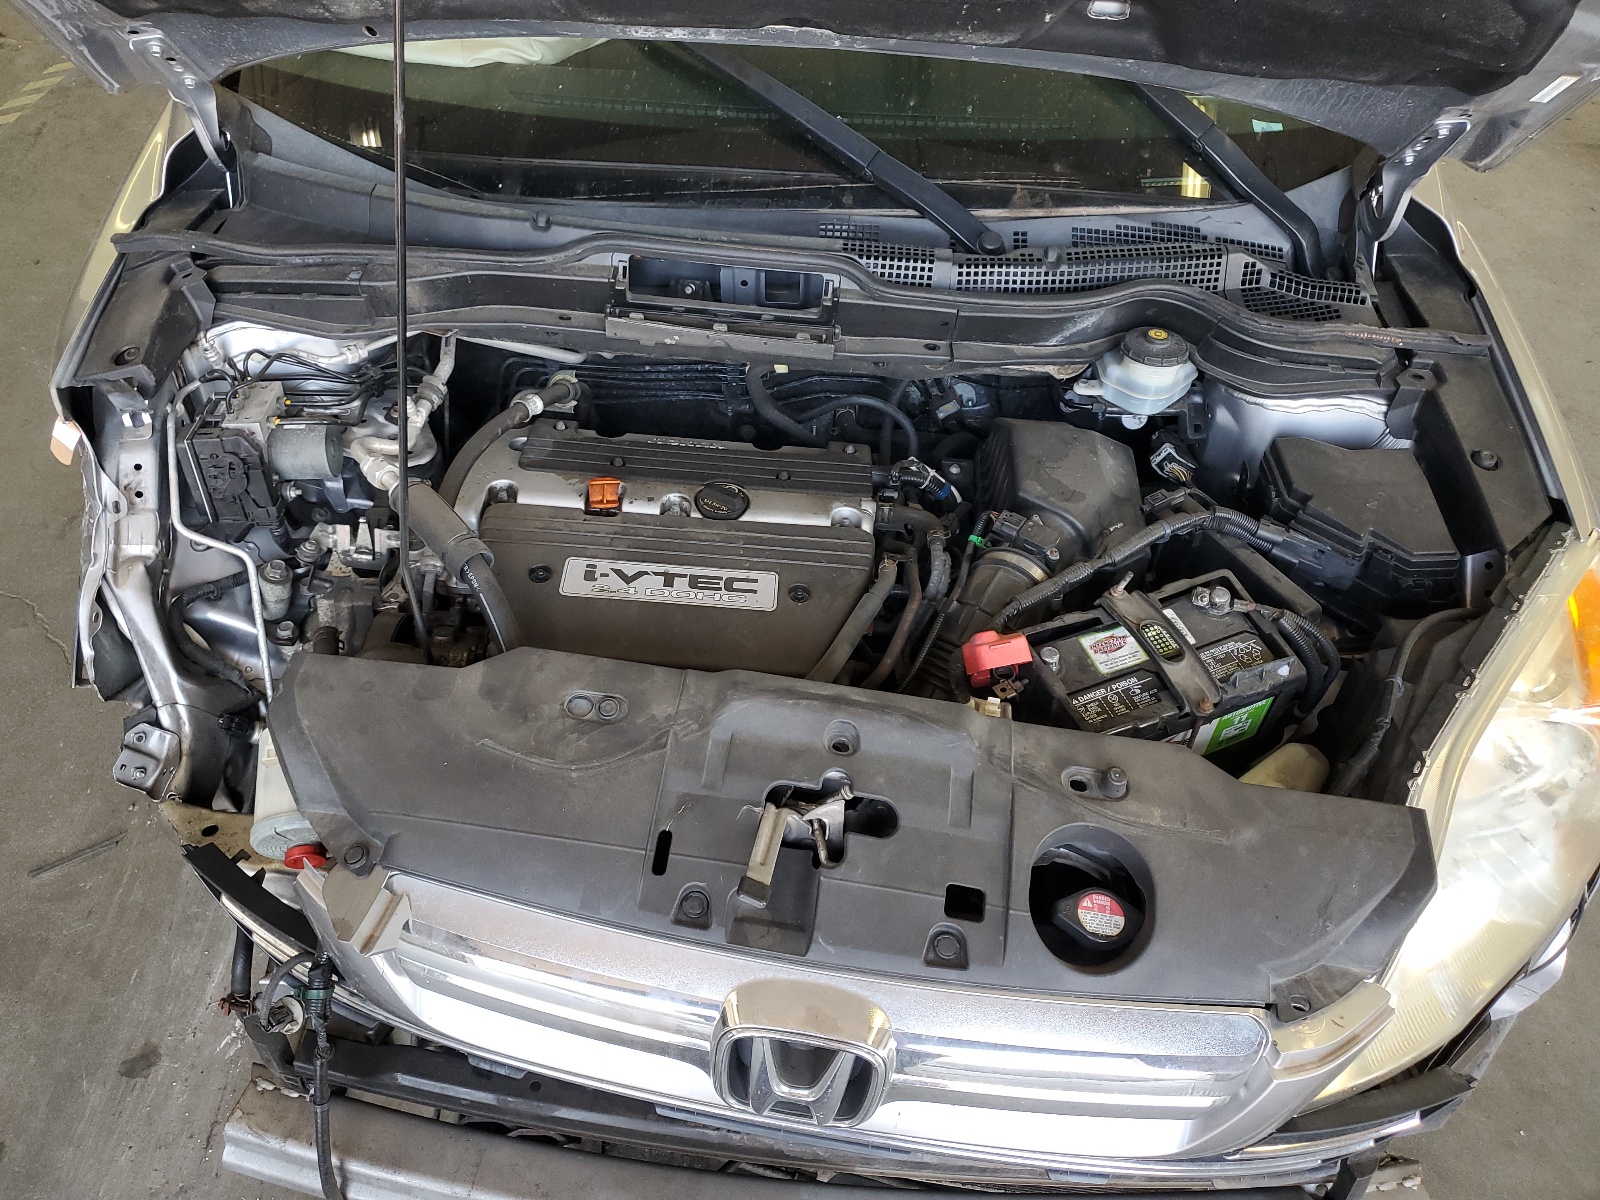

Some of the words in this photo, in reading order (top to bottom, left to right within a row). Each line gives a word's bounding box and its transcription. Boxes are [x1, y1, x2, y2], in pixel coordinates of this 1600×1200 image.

[583, 563, 759, 595] i-VTEC
[591, 584, 638, 595] 2.4
[644, 587, 748, 604] DOHC
[1077, 688, 1107, 702] DANGER
[1111, 676, 1138, 691] POISON
[1221, 699, 1267, 721] AUTOMOTIVE
